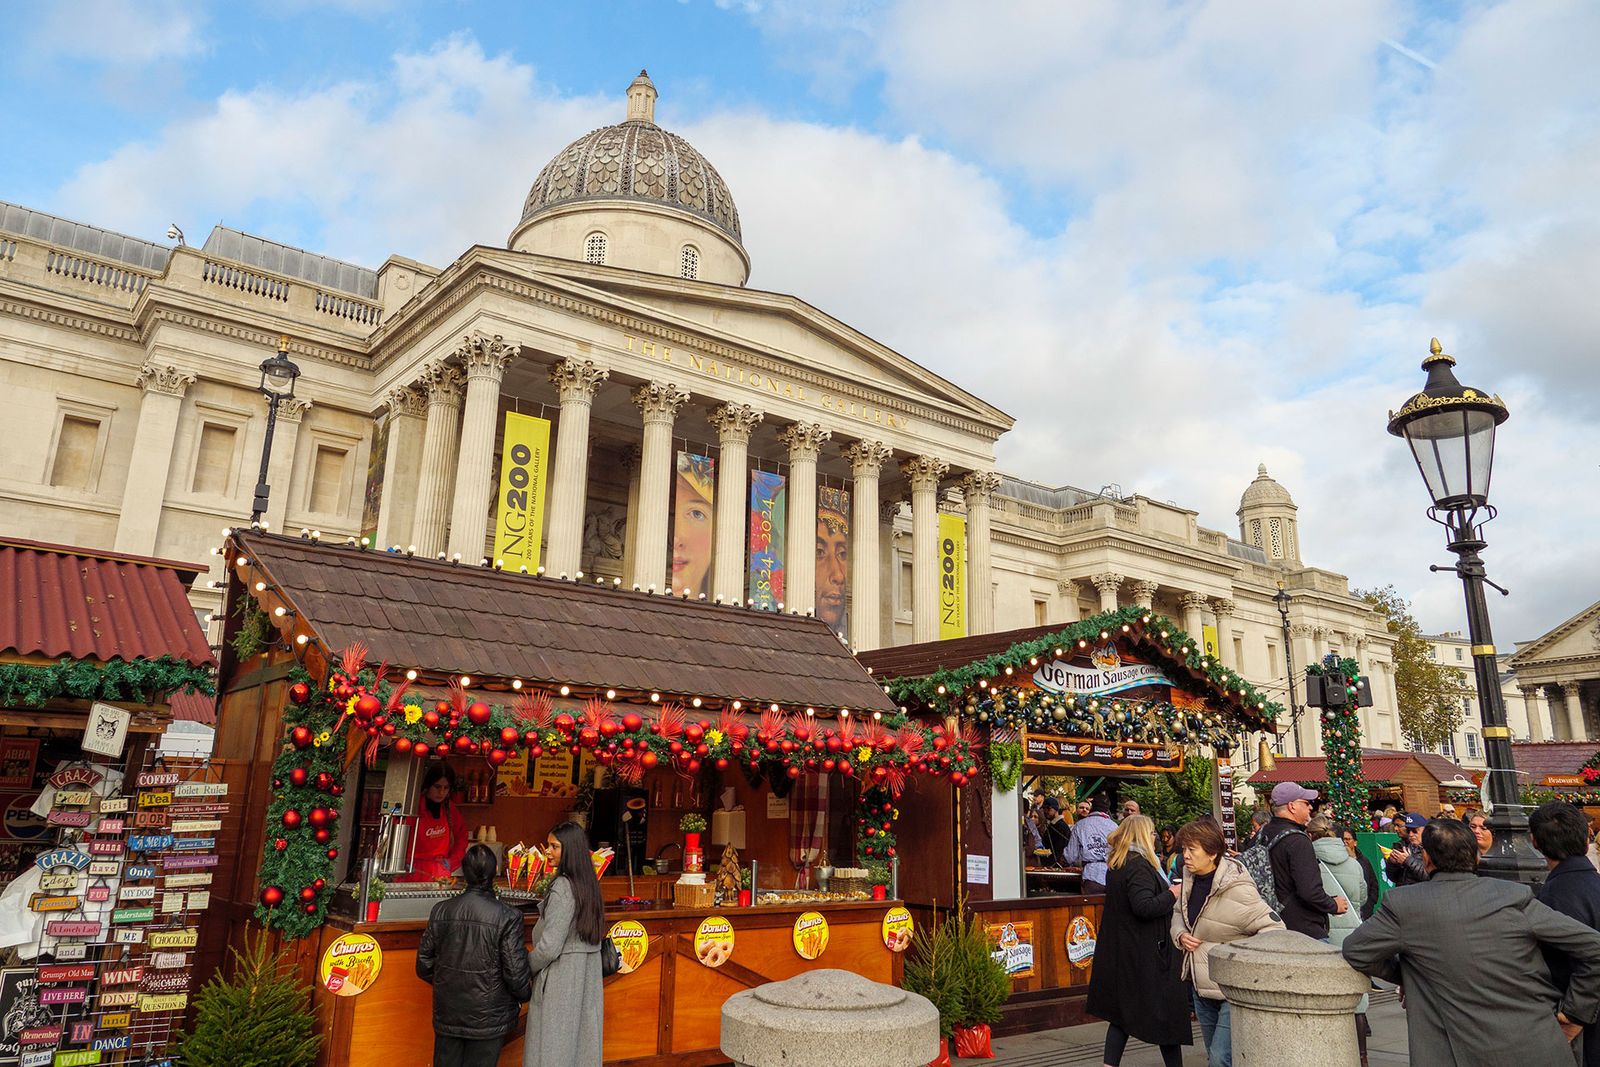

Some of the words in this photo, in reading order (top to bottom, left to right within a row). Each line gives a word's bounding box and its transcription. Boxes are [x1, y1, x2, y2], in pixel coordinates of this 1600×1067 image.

[623, 334, 673, 363] THE
[689, 353, 807, 401] NATIONAL
[821, 392, 909, 430] GALLERY
[502, 443, 532, 558] NG200
[529, 516, 535, 527] OF
[942, 537, 955, 627] NG200
[1040, 661, 1100, 690] German
[1103, 667, 1139, 686] Sausage
[4, 749, 31, 760] ABBA
[56, 769, 98, 786] CRAZY
[140, 773, 179, 786] COFFEE
[1547, 776, 1580, 784] Bratwurst
[176, 785, 199, 795] Toilet
[203, 785, 226, 794] Rules
[146, 794, 170, 805] Tea
[101, 801, 127, 811] Girls
[100, 820, 122, 831] just
[149, 816, 164, 824] OR
[94, 843, 121, 852] wanna
[41, 851, 86, 869] CRAZY
[91, 863, 116, 872] have
[129, 867, 153, 877] Only
[49, 876, 70, 887] dog
[89, 890, 109, 899] FUN
[113, 909, 154, 920] understands
[887, 913, 909, 924] Donuts
[701, 923, 730, 934] Donuts
[798, 917, 823, 931] Churros
[123, 932, 137, 941] ME
[612, 925, 643, 938] Churros
[154, 935, 195, 945] CHOCOLATE
[59, 948, 76, 957] and
[77, 948, 83, 956] a
[331, 940, 375, 957] Churros
[41, 971, 66, 980] Grumpy
[68, 969, 80, 978] Old
[81, 969, 95, 977] Man
[104, 969, 142, 985] WINE
[161, 977, 187, 988] CARES
[43, 992, 62, 1002] LIVE
[63, 991, 85, 1000] HERE
[103, 994, 135, 1005] DINE
[144, 1001, 177, 1011] QUESTION
[103, 1015, 127, 1025] and
[23, 1031, 60, 1040] Remember
[72, 1024, 92, 1041] IN
[94, 1036, 129, 1051] DANCE
[24, 1056, 33, 1065] as
[33, 1054, 43, 1063] far
[60, 1051, 96, 1066] WINE
